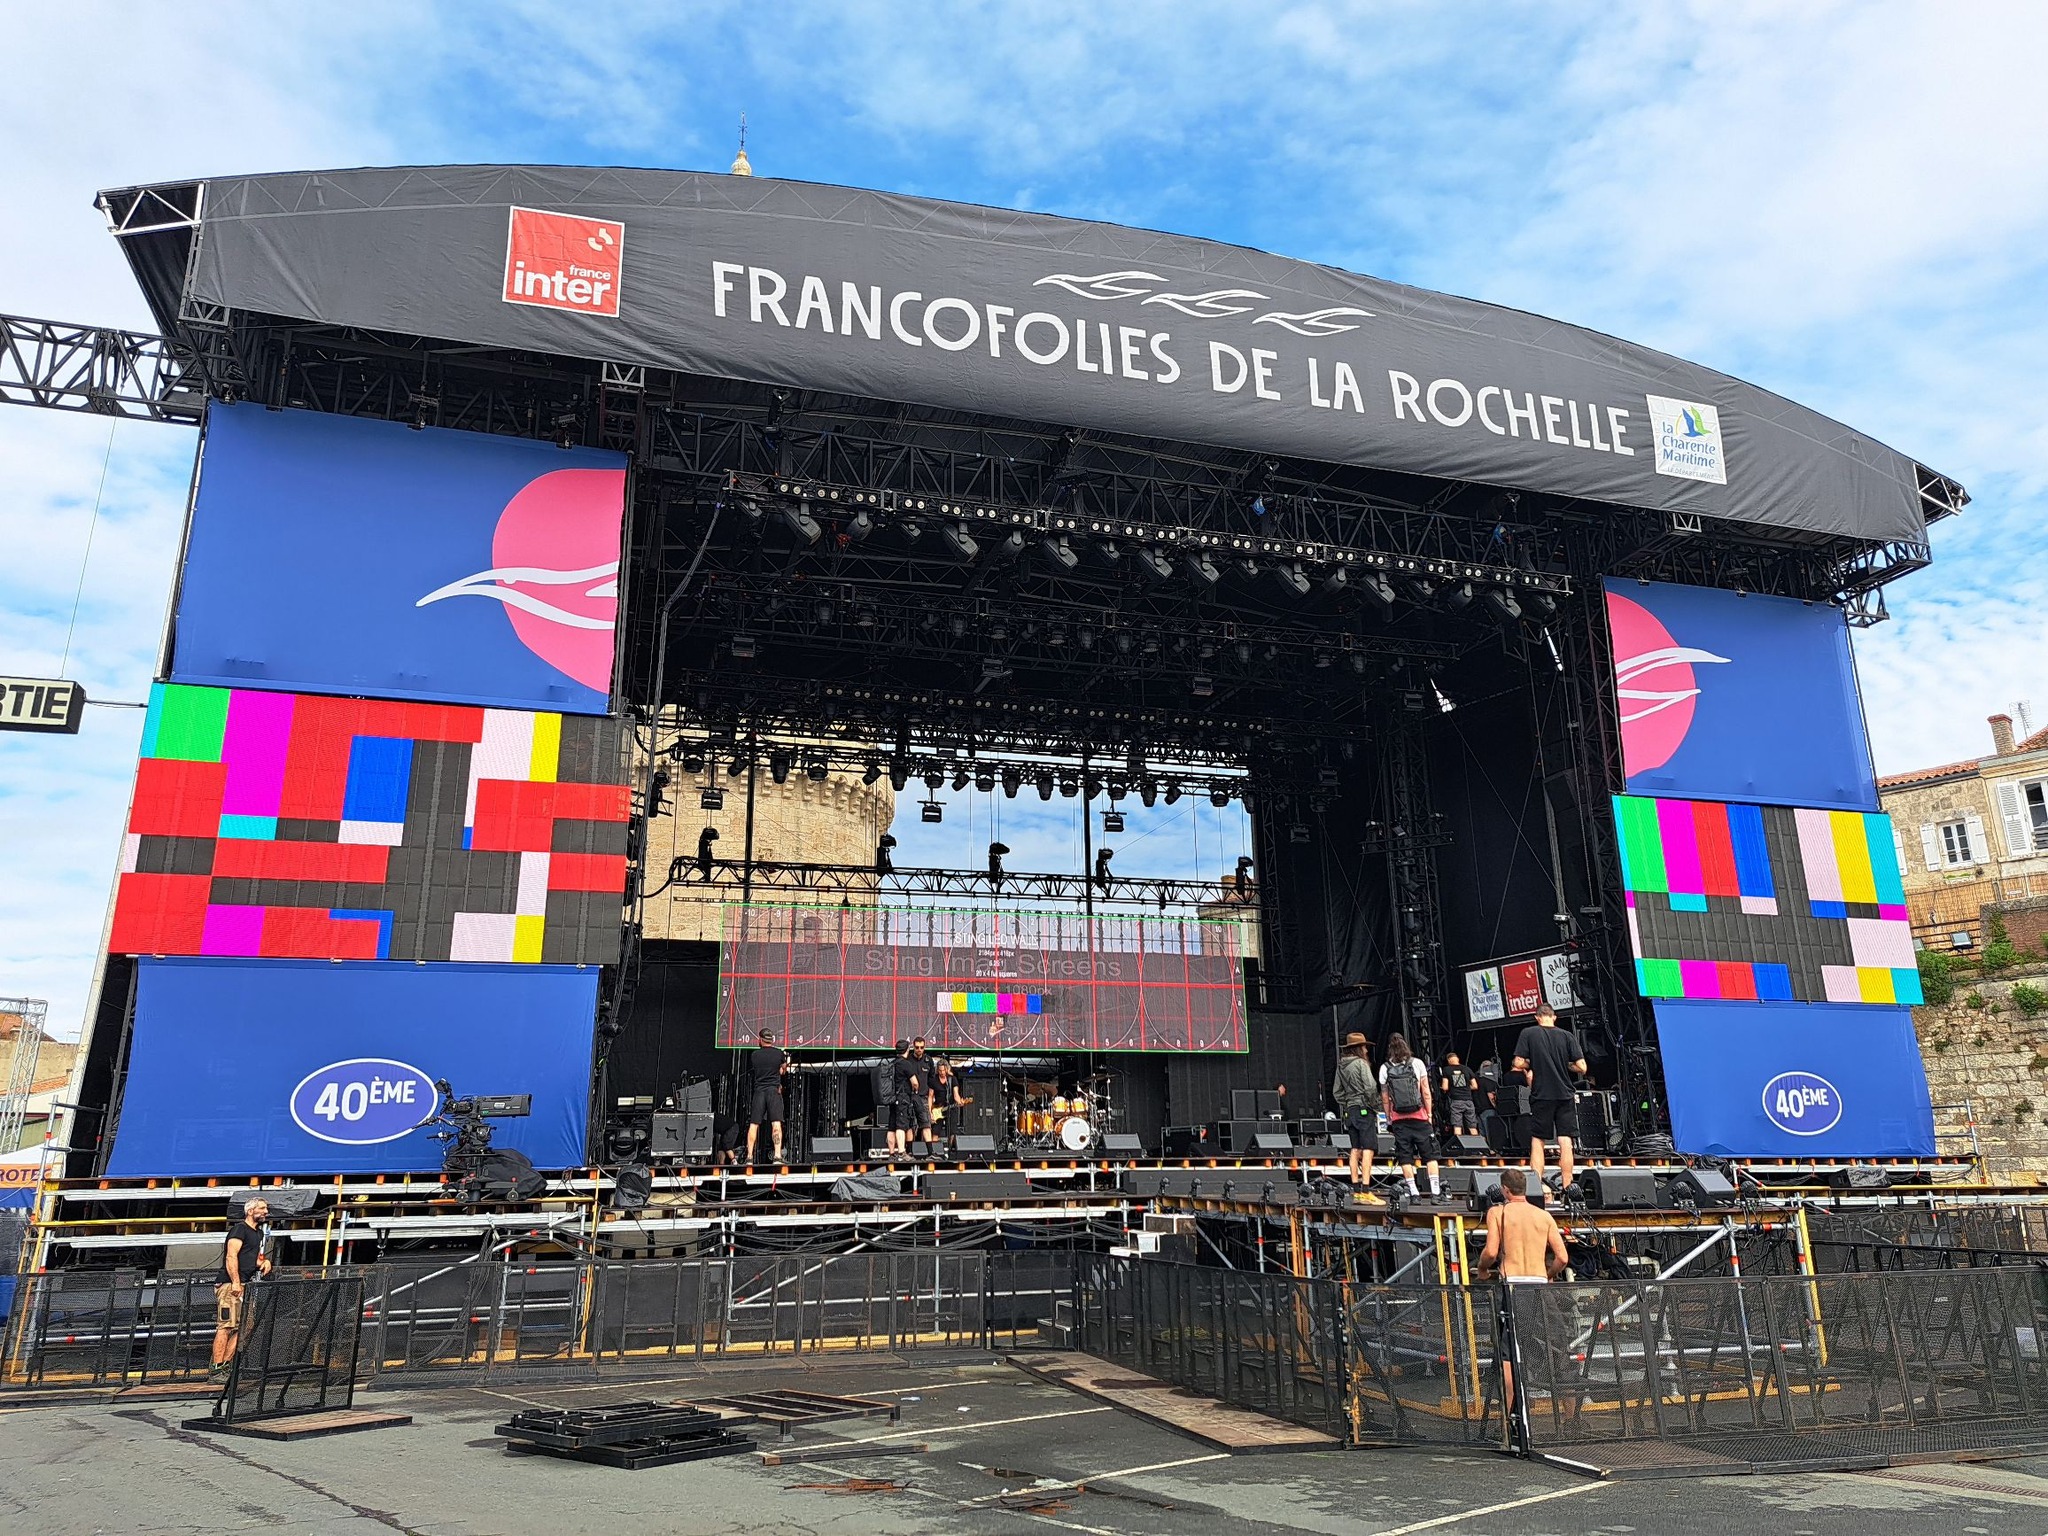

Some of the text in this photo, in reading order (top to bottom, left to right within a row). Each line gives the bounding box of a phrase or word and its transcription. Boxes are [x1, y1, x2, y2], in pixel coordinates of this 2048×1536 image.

[513, 260, 611, 306] inter
[569, 264, 611, 280] france
[712, 260, 1635, 457] FRANCOFOLIES DE LA ROCHELLE
[1662, 421, 1674, 433] la
[1662, 435, 1716, 455] Charente
[1662, 448, 1716, 468] Maritime
[865, 950, 933, 976] Sting
[1508, 994, 1538, 1012] inter
[313, 1075, 417, 1121] 40ÈME
[1776, 1084, 1830, 1118] 40ÈME
